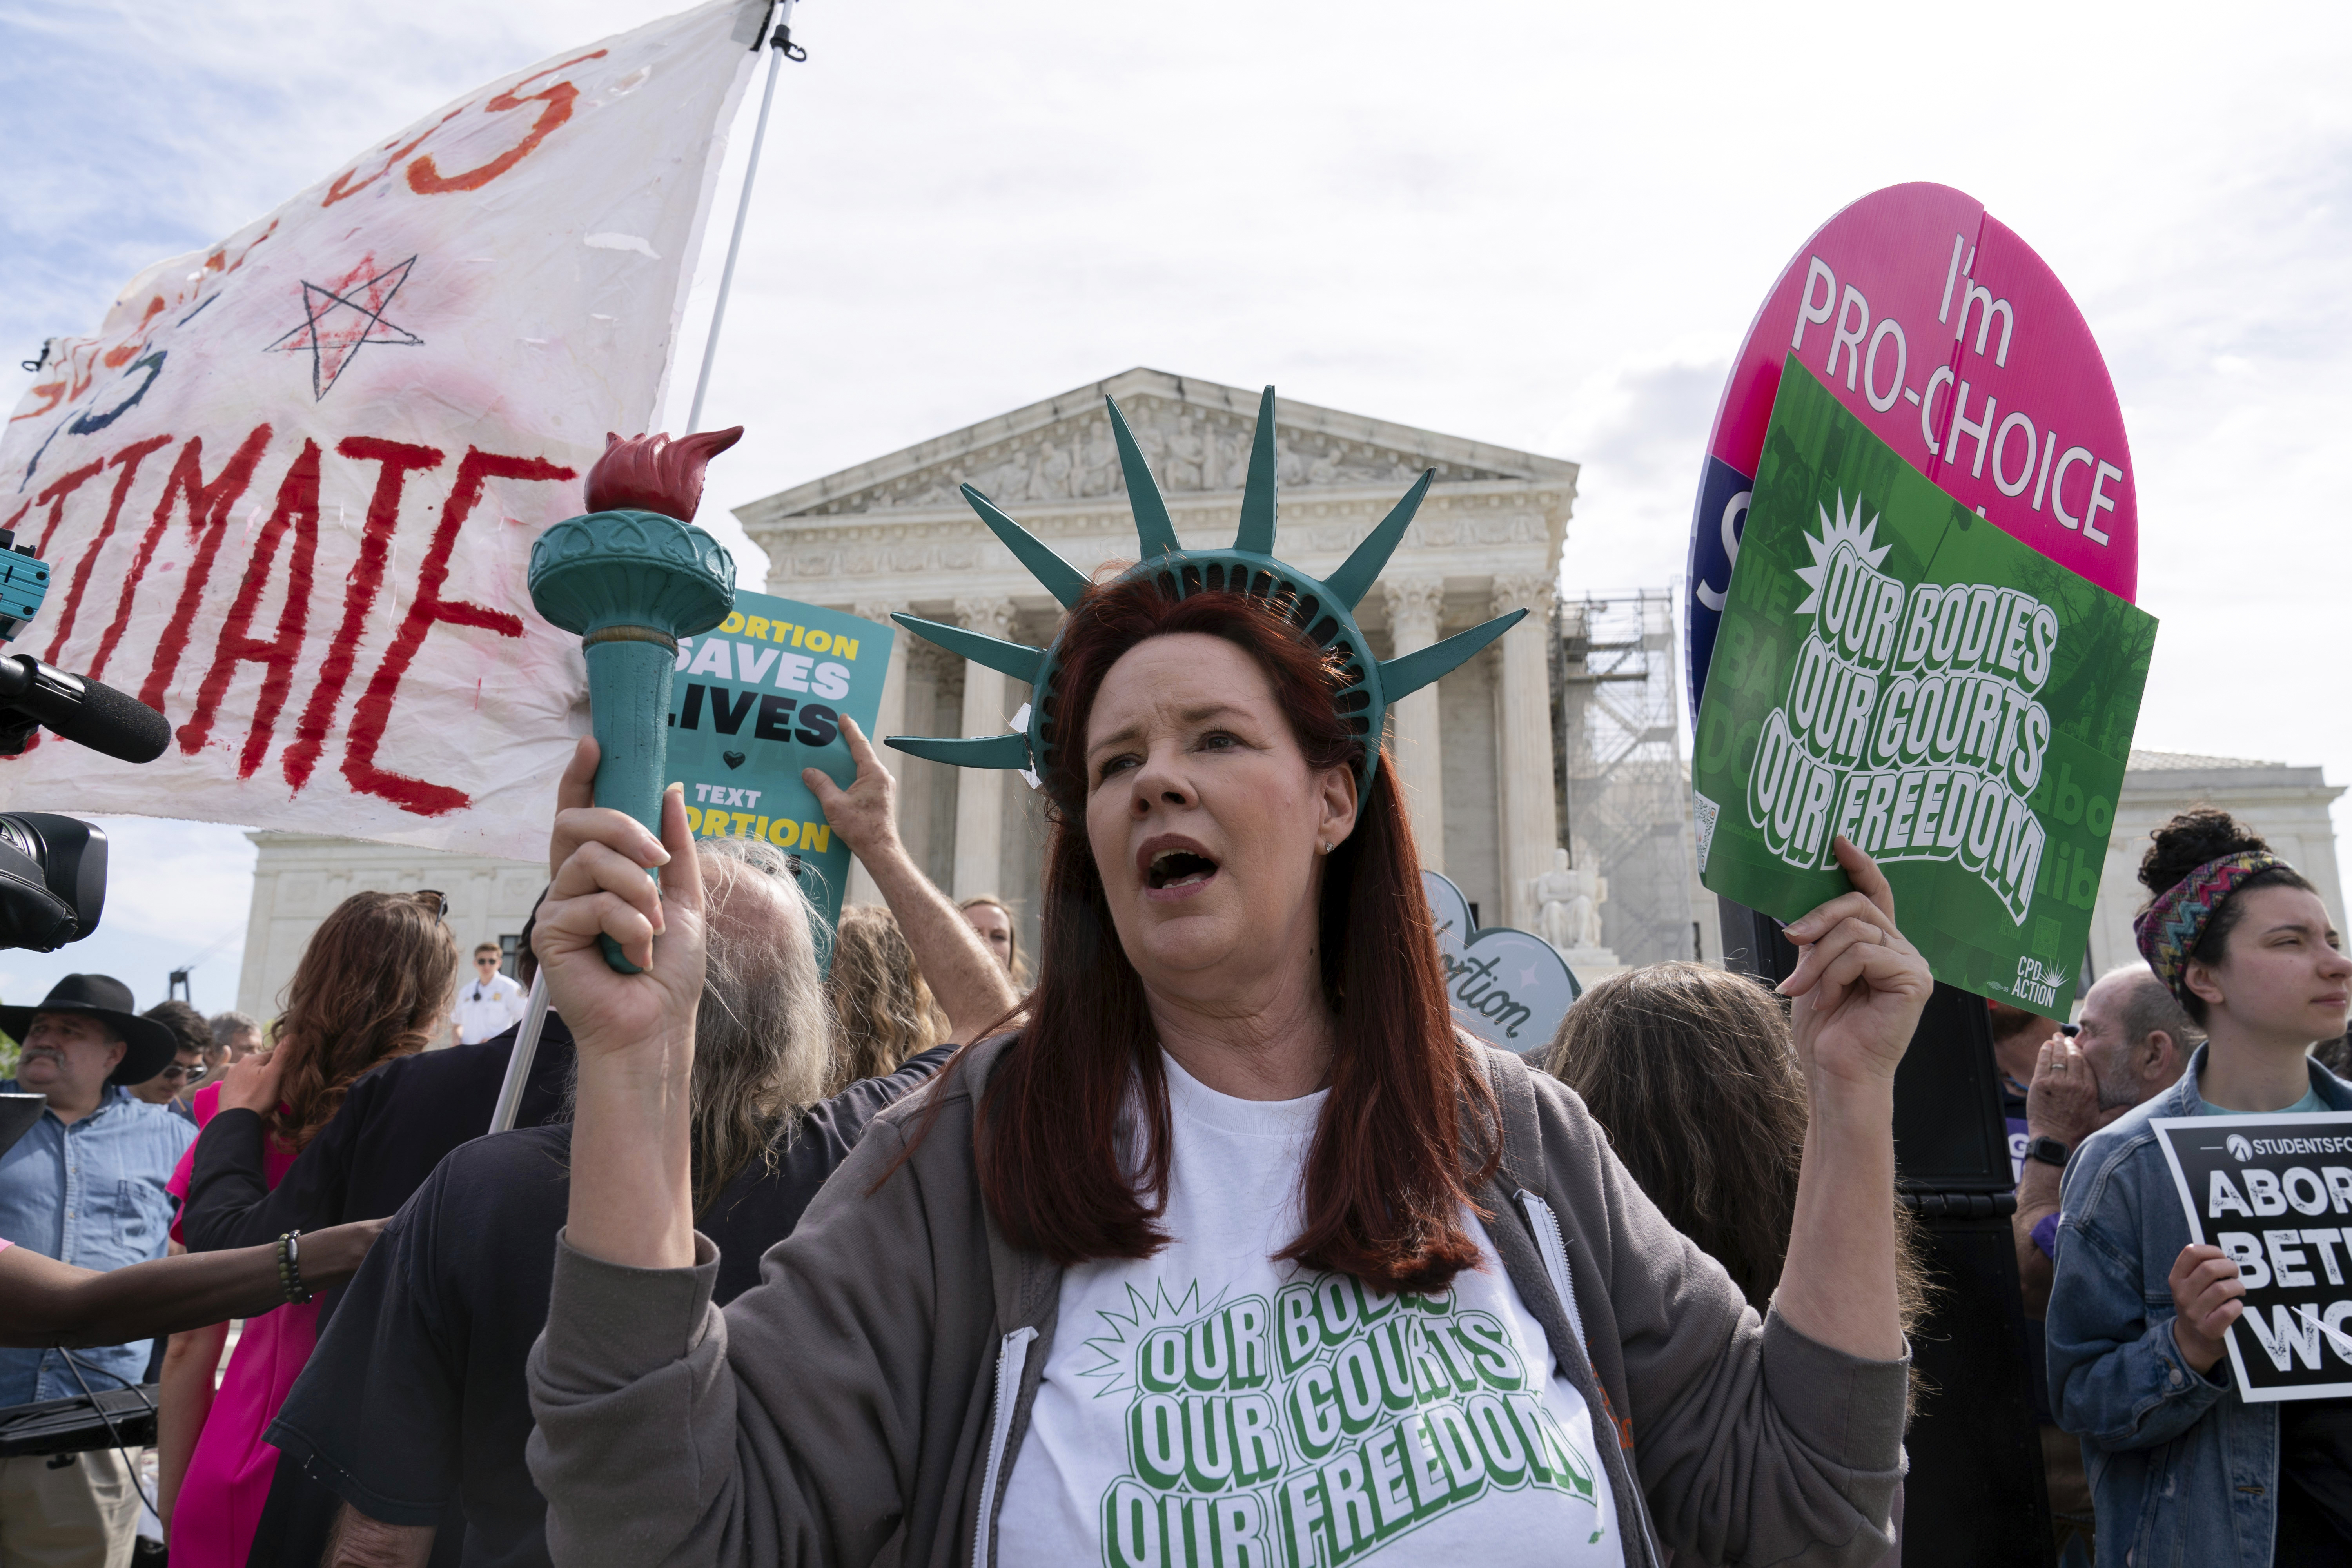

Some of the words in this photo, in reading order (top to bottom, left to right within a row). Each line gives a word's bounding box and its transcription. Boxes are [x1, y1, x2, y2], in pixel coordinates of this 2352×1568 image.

[1938, 232, 2014, 369] I'm
[1790, 254, 2123, 548] PRO-CHOICE
[0, 423, 580, 817] TIMATE
[713, 611, 860, 661] ORTION
[1821, 544, 1902, 674] OUR
[1896, 588, 2055, 692] BODIES
[668, 683, 838, 747] IVES
[1699, 699, 1762, 790] DO
[1791, 634, 1876, 764] OUR
[1872, 678, 2049, 792] COURTS
[684, 806, 831, 853] ORTION
[695, 783, 761, 809] TEXT
[1750, 710, 1834, 866] OUR
[1833, 769, 2045, 921] FREEDOM
[2025, 762, 2113, 837] abo
[2037, 834, 2099, 910] lib
[2011, 976, 2056, 1008] ACTION
[2017, 956, 2042, 981] CPD
[2209, 1166, 2352, 1218] ABOR
[1139, 1298, 1270, 1393] OUR
[2242, 1300, 2352, 1372] WO
[1133, 1394, 1283, 1492] OUR
[1288, 1313, 1525, 1462] COURTS
[1103, 1482, 1266, 1568] OUR
[1279, 1392, 1594, 1568] FREEDOM
